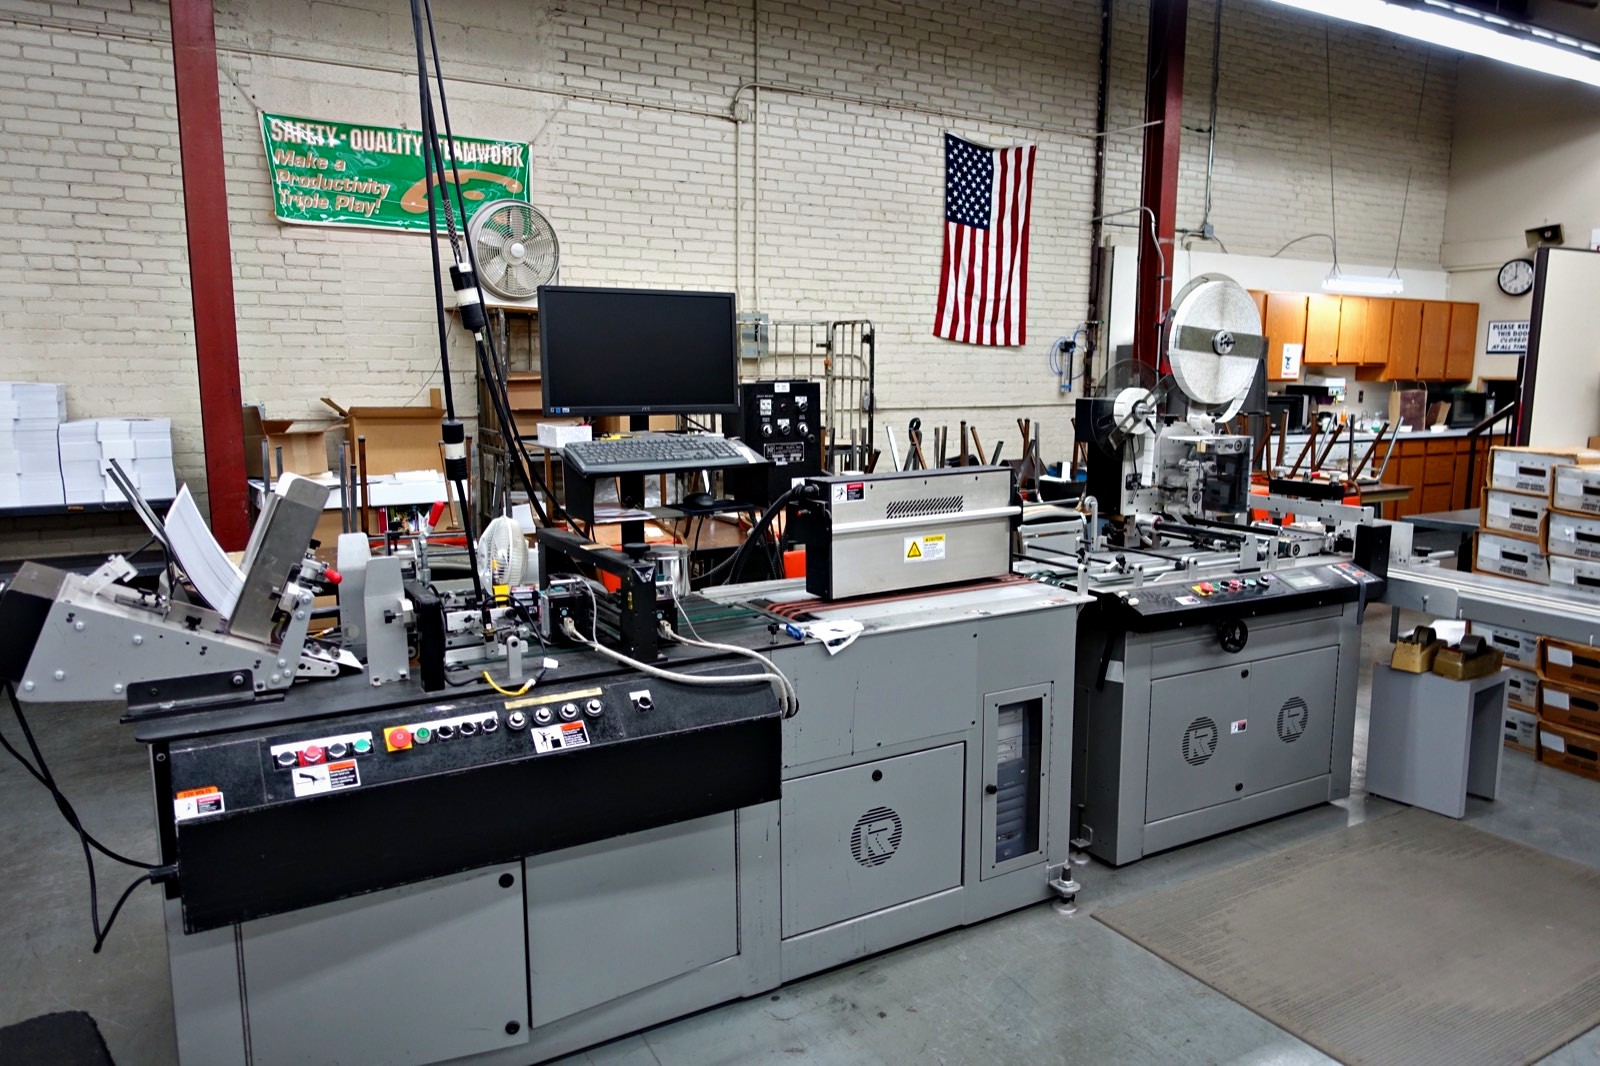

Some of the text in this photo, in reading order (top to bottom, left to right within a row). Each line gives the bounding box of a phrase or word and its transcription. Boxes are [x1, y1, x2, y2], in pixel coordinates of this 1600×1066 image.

[270, 118, 338, 148] SAFETY
[350, 128, 423, 157] QUALITY
[274, 148, 346, 172] Make a
[276, 169, 391, 200] Productivity
[279, 188, 382, 218] Triple Play!
